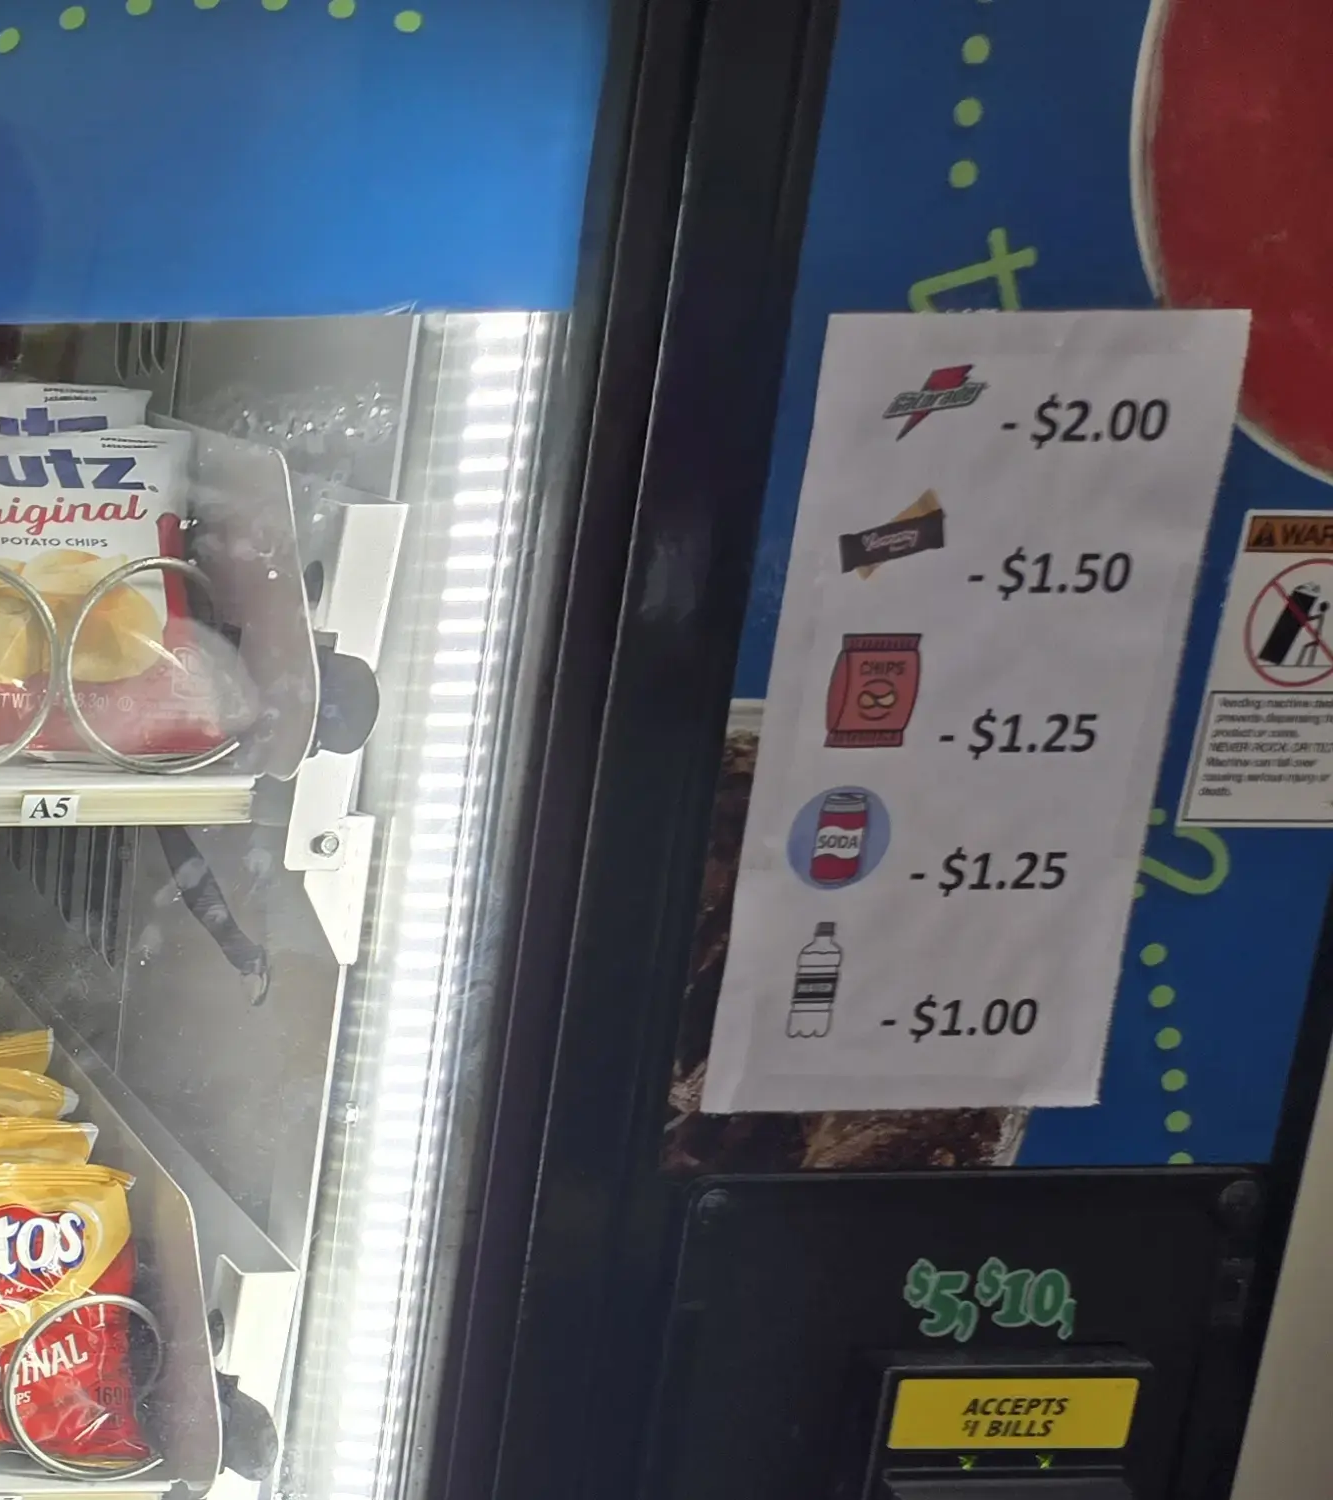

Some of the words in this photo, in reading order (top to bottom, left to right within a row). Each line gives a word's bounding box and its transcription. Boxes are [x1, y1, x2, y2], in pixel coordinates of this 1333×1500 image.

[1030, 396, 1170, 448] $2.00
[0, 536, 61, 548] POTATO
[65, 537, 108, 548] CHIPS
[997, 549, 1132, 601] $1.50
[860, 660, 905, 676] CHIPS
[968, 708, 1098, 760] $1.25
[29, 798, 69, 819] A5
[818, 833, 859, 851] SODA
[938, 847, 1068, 897] $1.25
[909, 996, 1039, 1043] $1.00
[962, 1398, 1069, 1416] ACCEPTS
[984, 1418, 1054, 1439] BILLS
